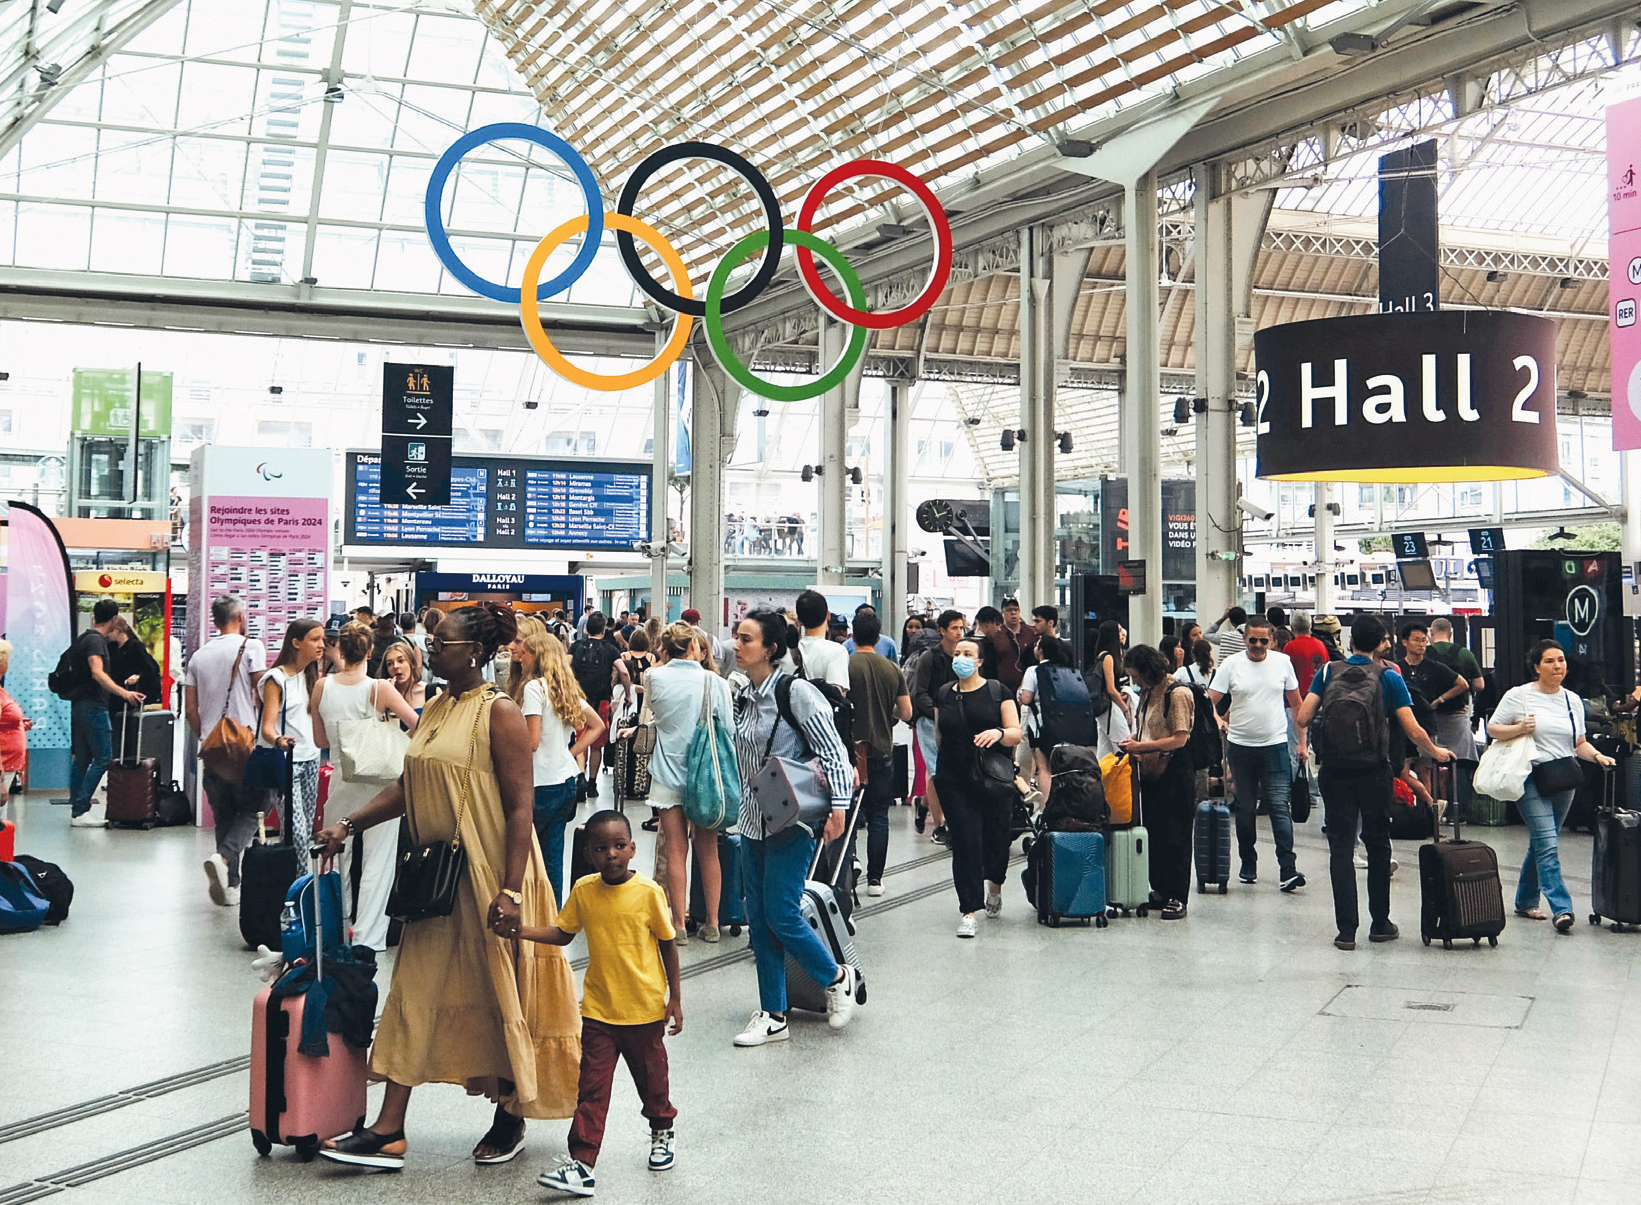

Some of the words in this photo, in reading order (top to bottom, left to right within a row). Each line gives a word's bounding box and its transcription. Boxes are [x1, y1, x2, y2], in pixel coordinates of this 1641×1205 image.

[1613, 192, 1621, 201] 10
[1622, 190, 1636, 199] min
[1423, 292, 1434, 311] 3
[1618, 307, 1634, 320] RER
[1257, 369, 1270, 435] 2
[1301, 353, 1480, 429] Hall
[1512, 355, 1540, 424] 2
[402, 396, 434, 404] Toilettes
[356, 455, 381, 464] Dépar
[406, 466, 427, 474] Sortie
[210, 506, 253, 515] Rejoindre
[270, 507, 290, 515] sites
[210, 516, 261, 526] Olympiques
[302, 518, 322, 526] 2024
[1168, 540, 1191, 548] VIDÉO
[1404, 541, 1416, 552] 23
[1480, 537, 1492, 548] 21
[472, 574, 525, 583] DALLOYAU
[1574, 598, 1589, 623] M
